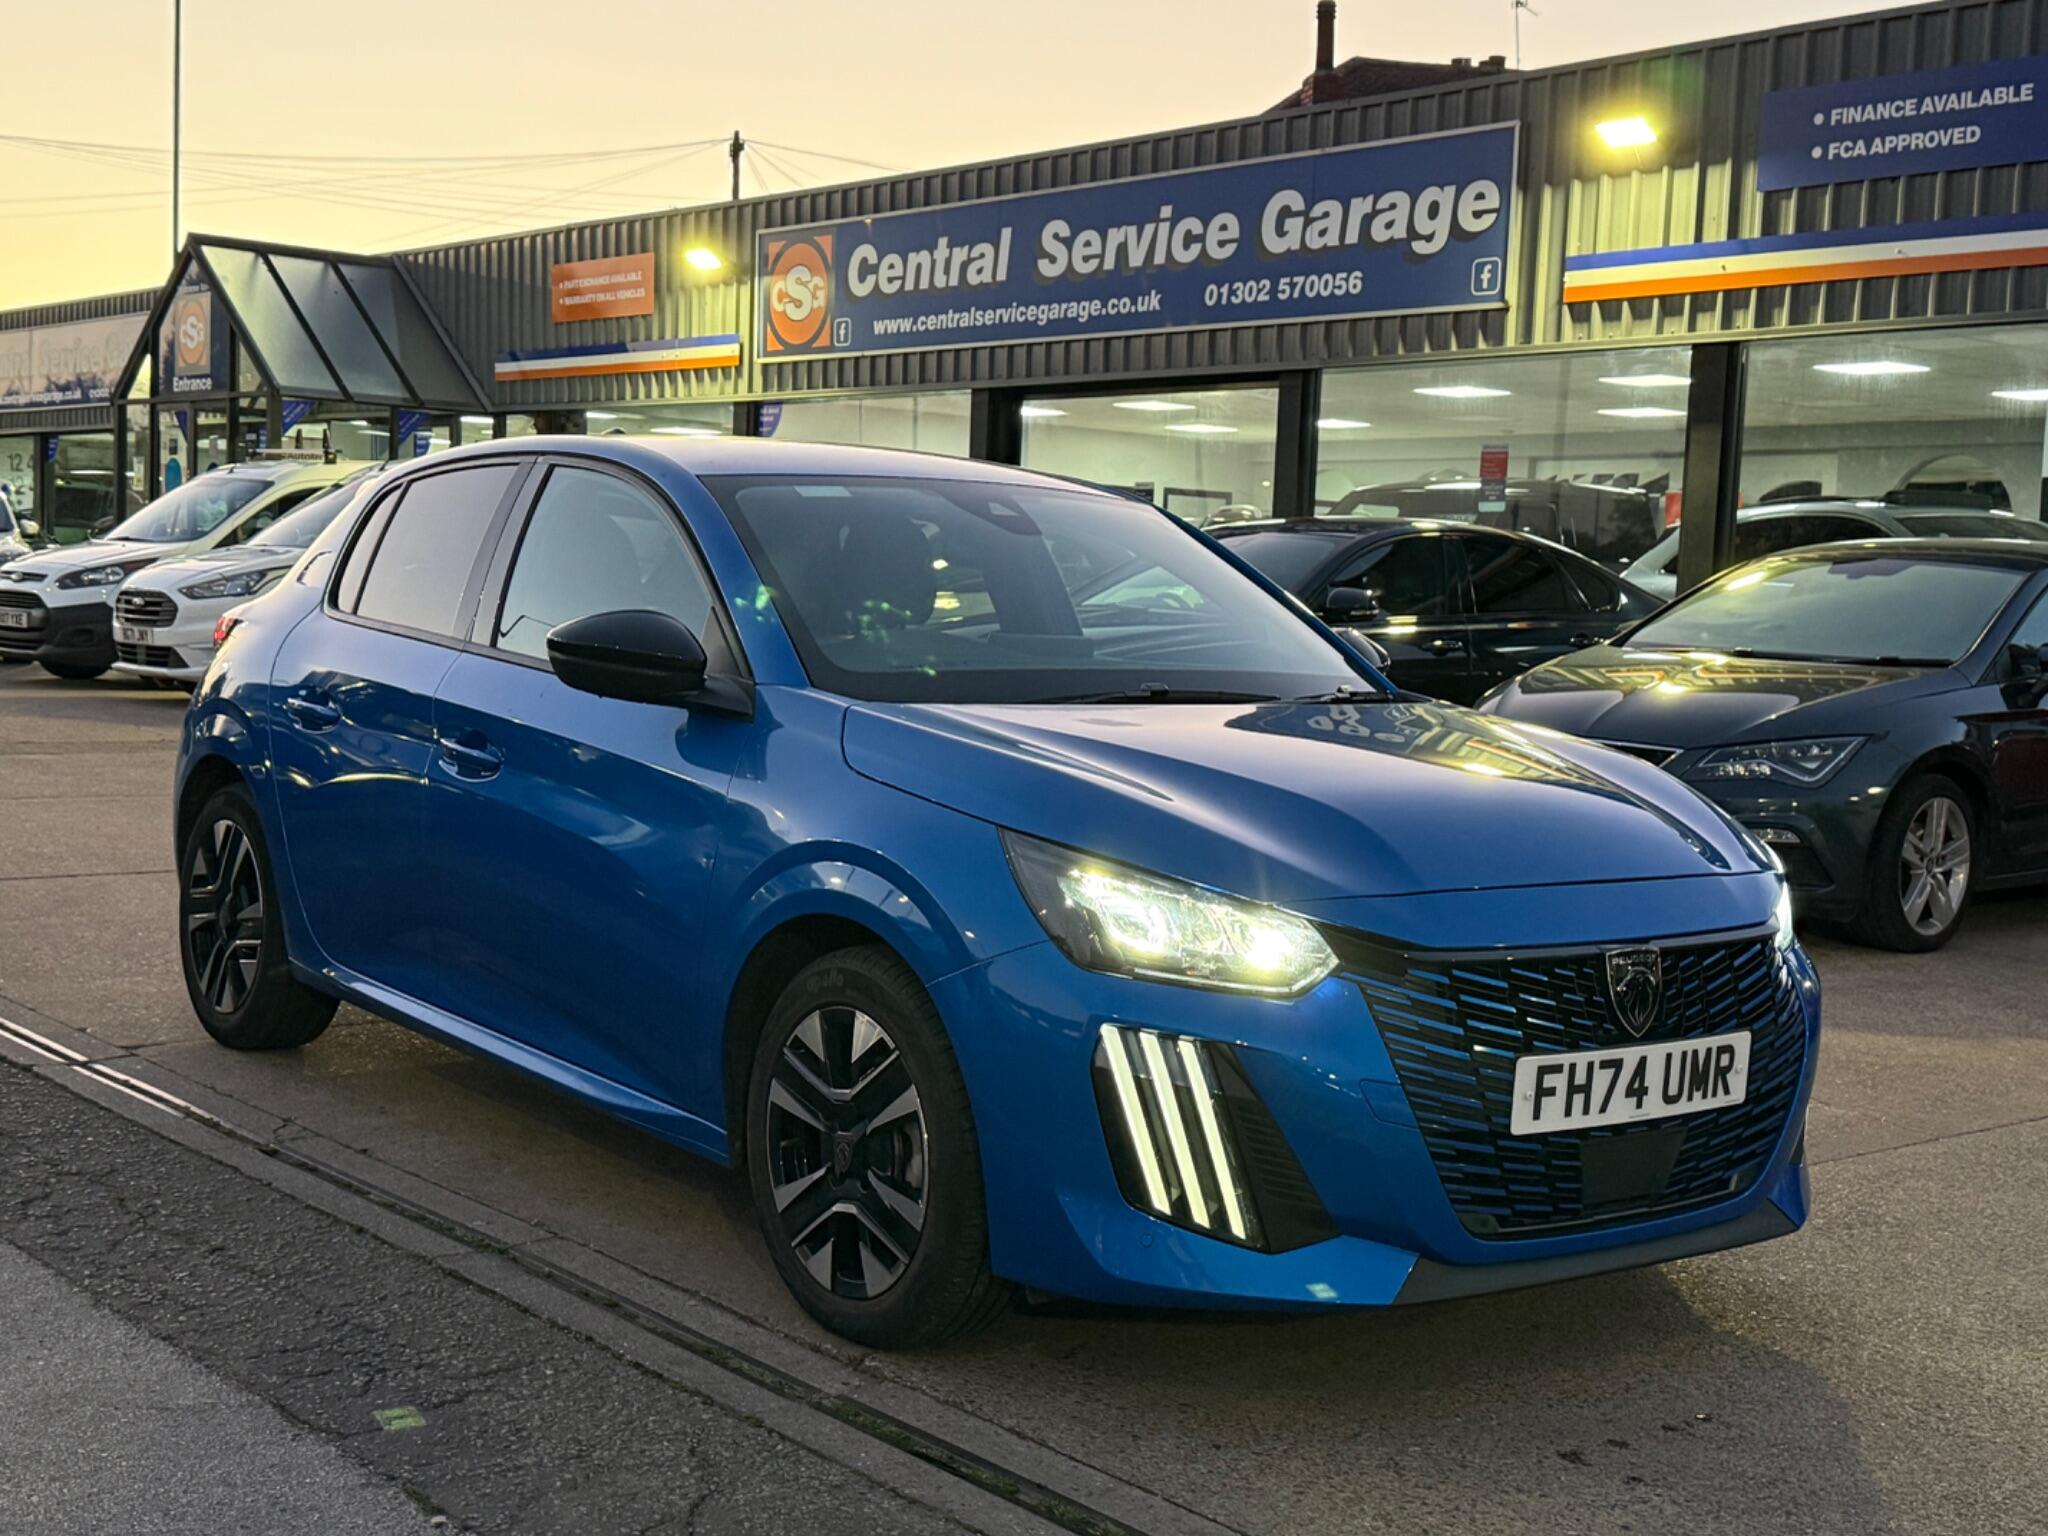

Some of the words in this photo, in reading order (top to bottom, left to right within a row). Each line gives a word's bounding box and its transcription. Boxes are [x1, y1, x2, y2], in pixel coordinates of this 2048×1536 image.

[1831, 99, 1917, 126] FINANCE
[1920, 83, 2034, 115] AVAILABLE
[1828, 139, 1867, 160] FCA
[1869, 125, 1981, 155] APPROVED
[848, 227, 1012, 298] Central
[1037, 205, 1240, 278] Service
[1261, 179, 1500, 255] Garage
[1204, 279, 1270, 306] 01302
[1277, 271, 1363, 300] 570056
[873, 290, 1163, 335] www.centralservicegarage.co.uk
[173, 376, 212, 393] Entrance
[1611, 953, 1657, 965] PEUGEOT
[1532, 1055, 1648, 1121] FH74
[1661, 1044, 1735, 1105] UMR
